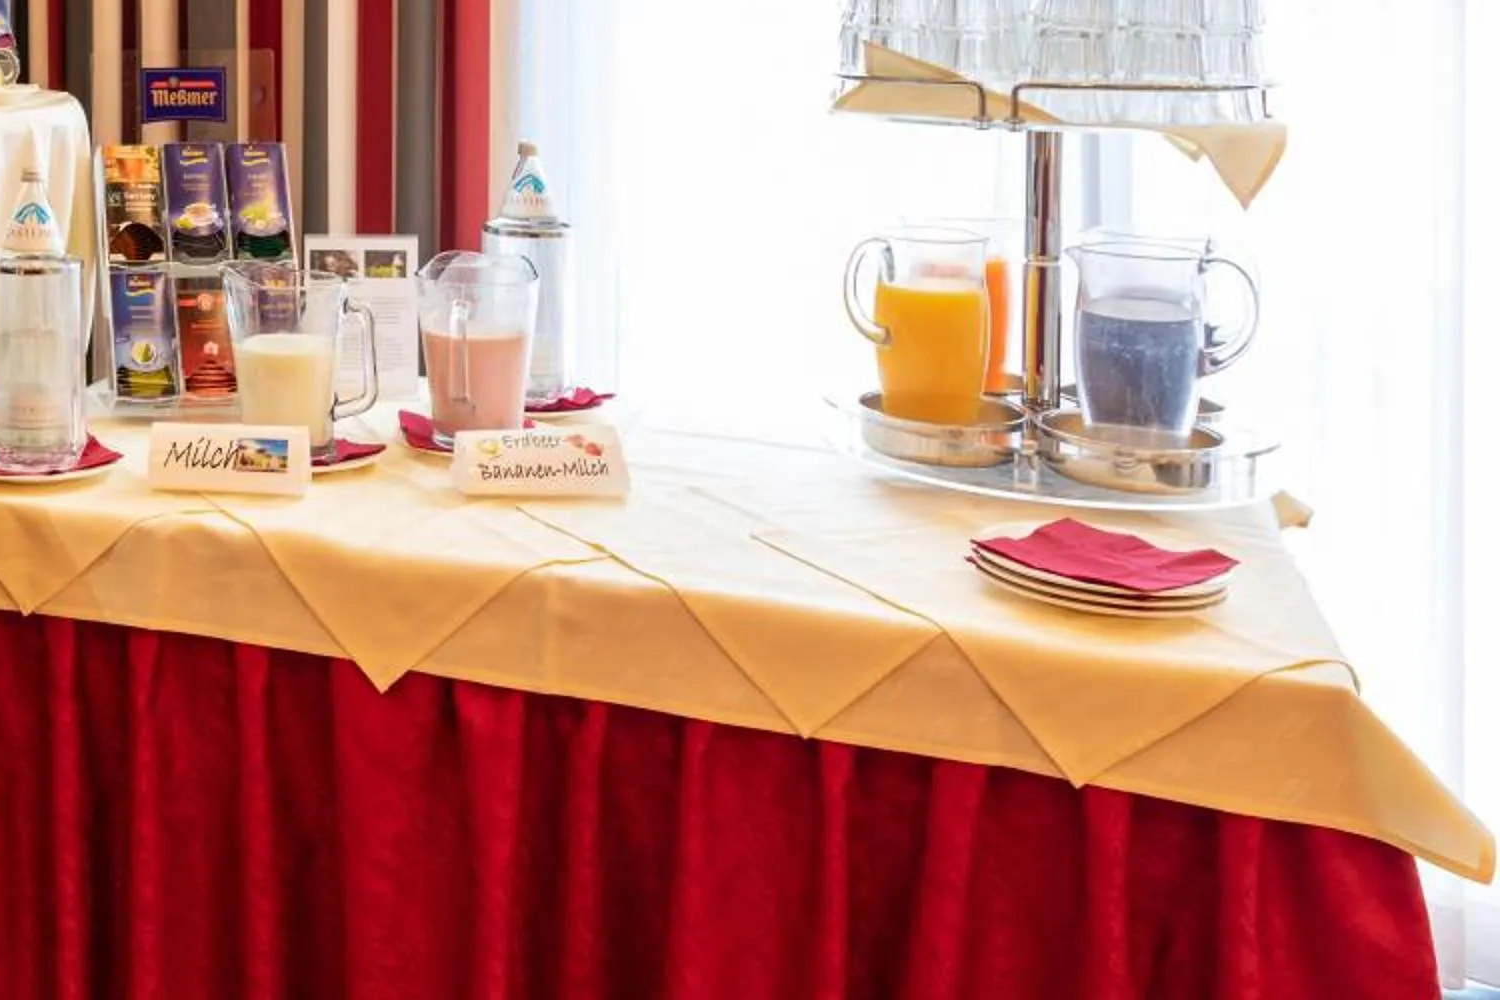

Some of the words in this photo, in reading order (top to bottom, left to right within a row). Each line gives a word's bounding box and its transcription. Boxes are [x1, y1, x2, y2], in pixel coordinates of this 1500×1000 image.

[151, 89, 217, 107] Meßmer
[163, 437, 239, 471] Milch
[477, 457, 609, 481] Bananen-Milch
